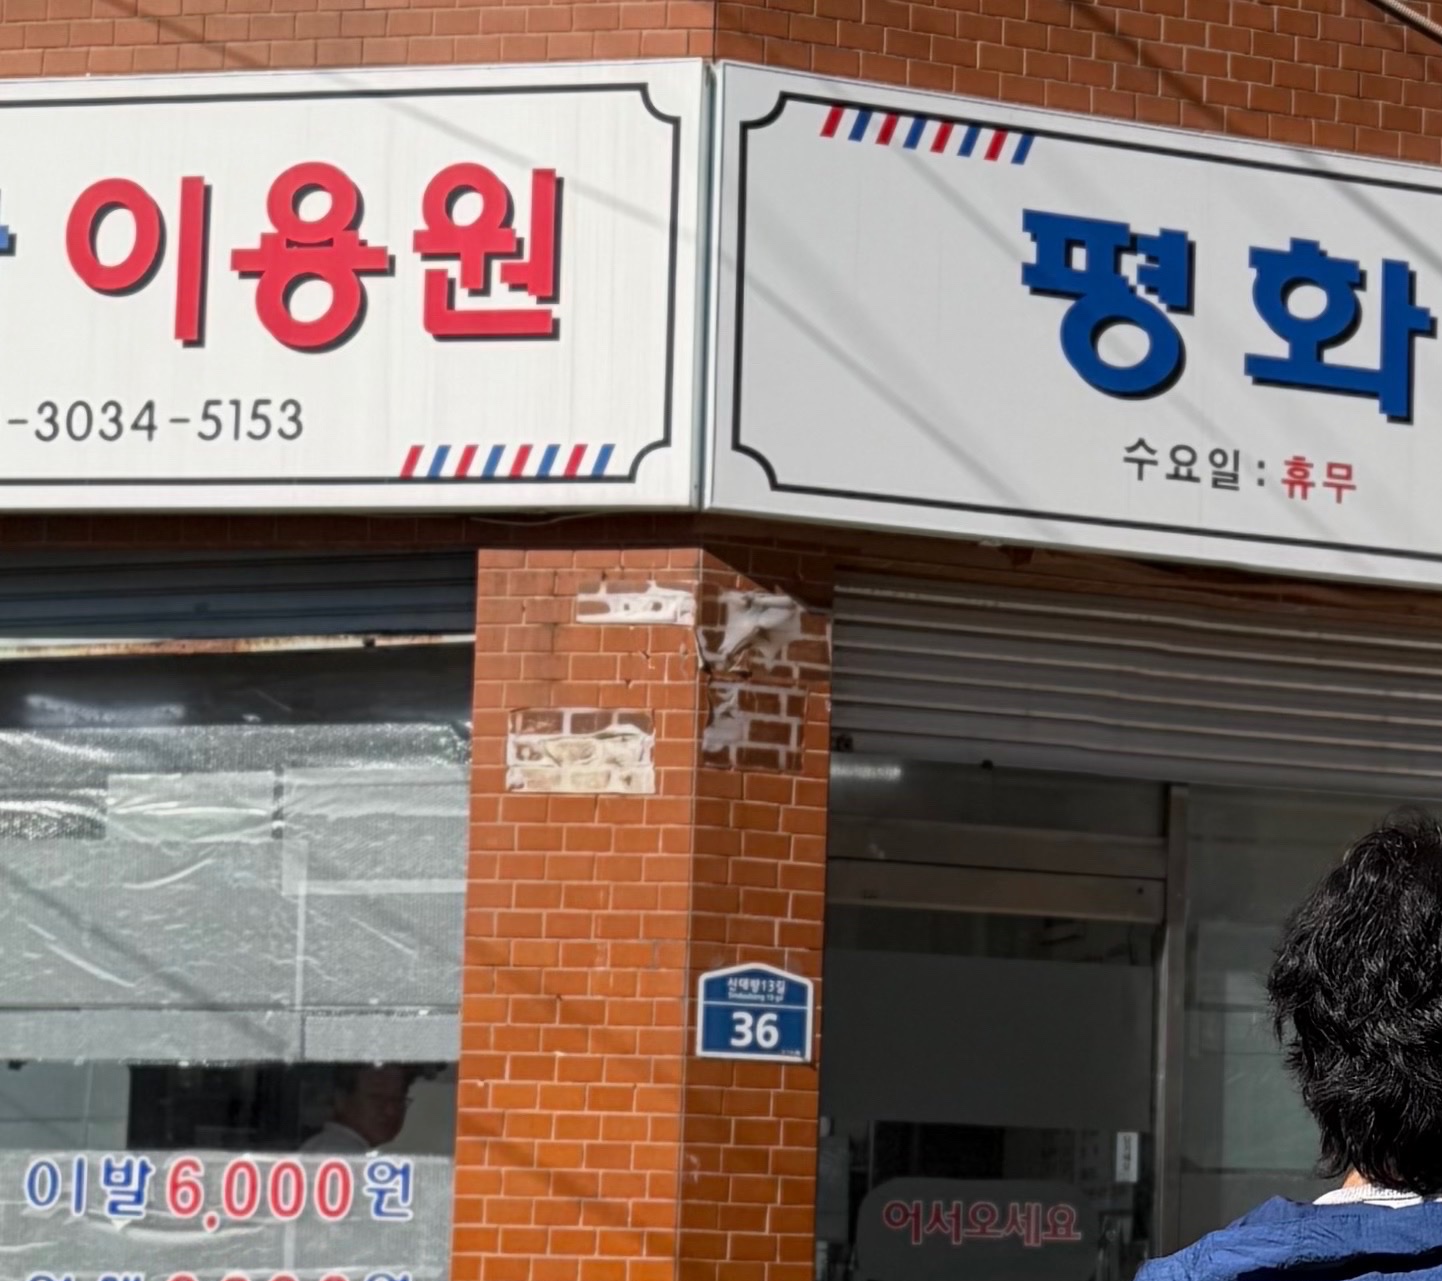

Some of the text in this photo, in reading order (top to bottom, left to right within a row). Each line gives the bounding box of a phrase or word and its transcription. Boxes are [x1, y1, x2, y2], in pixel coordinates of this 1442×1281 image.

[66, 161, 561, 354] 이용원
[1022, 208, 1438, 425] 평화
[730, 1011, 779, 1049] 36
[25, 1156, 155, 1217] 이발
[883, 1200, 1081, 1247] 어서오세요
